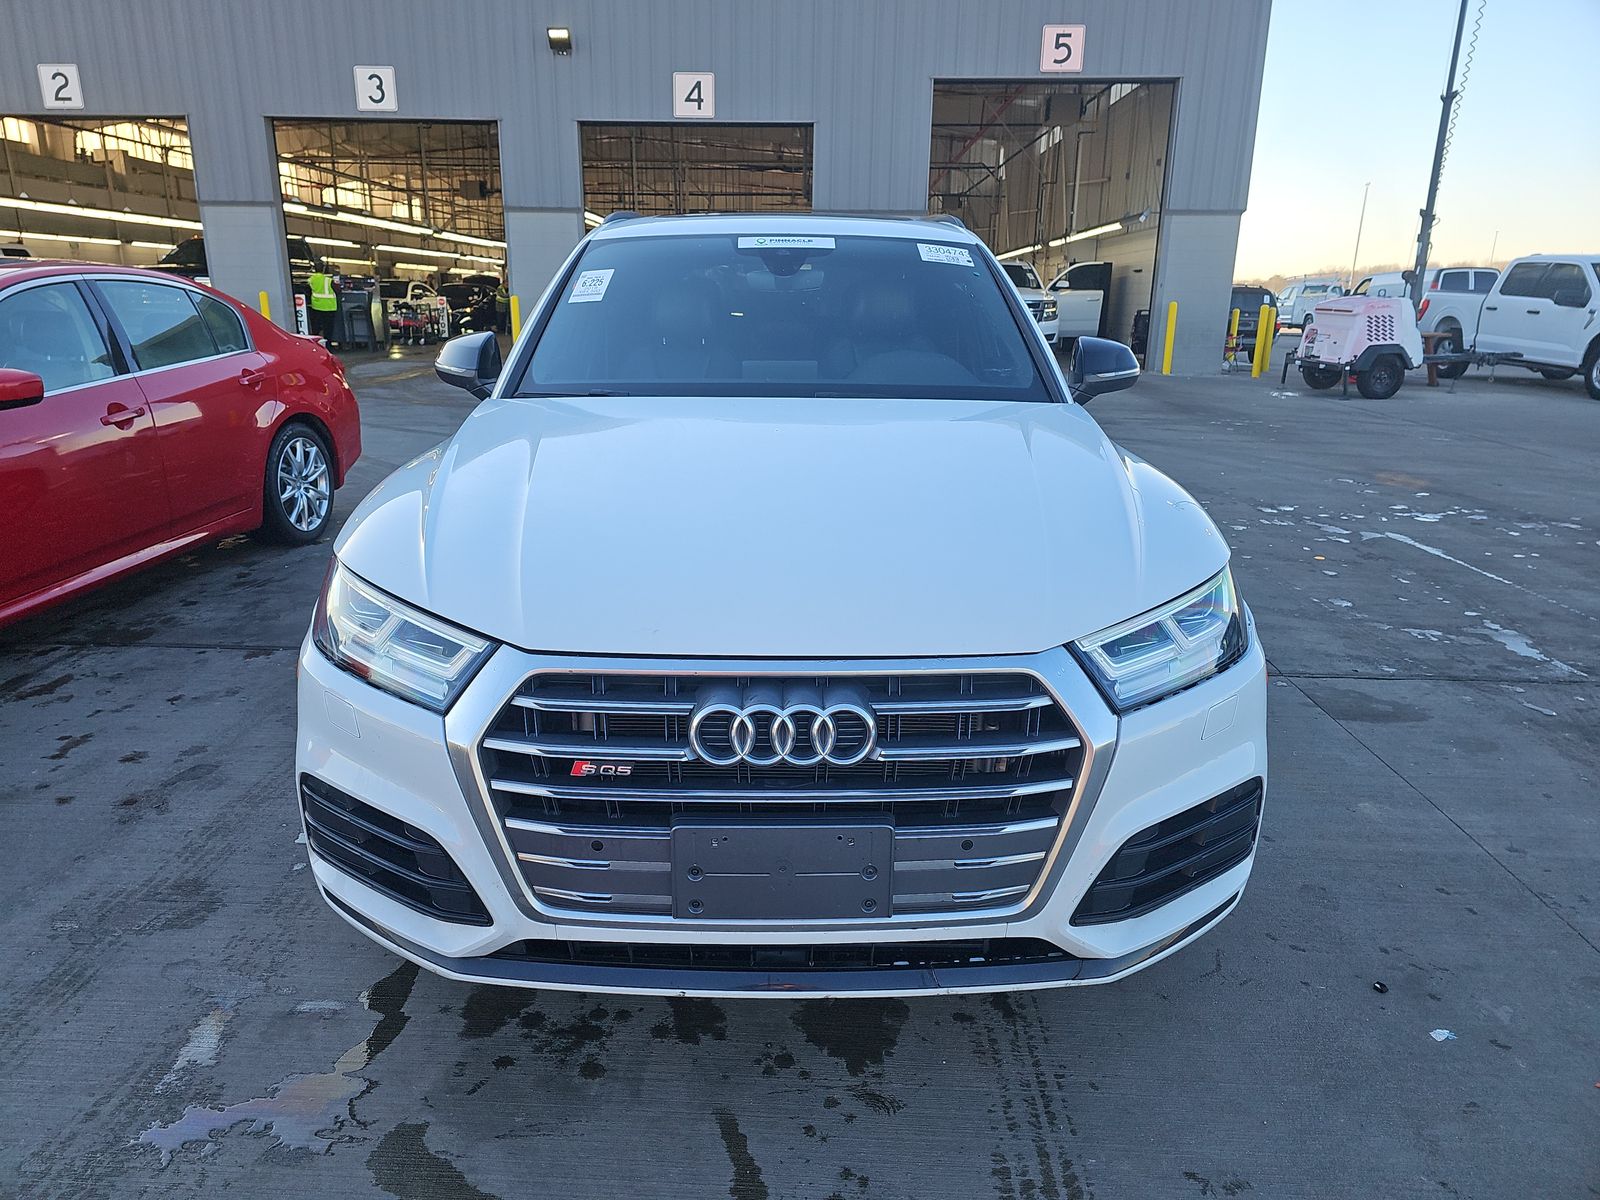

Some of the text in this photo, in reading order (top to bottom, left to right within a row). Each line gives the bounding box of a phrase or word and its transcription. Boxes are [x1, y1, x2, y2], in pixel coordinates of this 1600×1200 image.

[1053, 34, 1072, 65] 5
[51, 72, 72, 102] 2
[367, 74, 386, 104] 3
[684, 80, 704, 110] 4
[296, 309, 306, 335] STO
[438, 306, 446, 336] STOP
